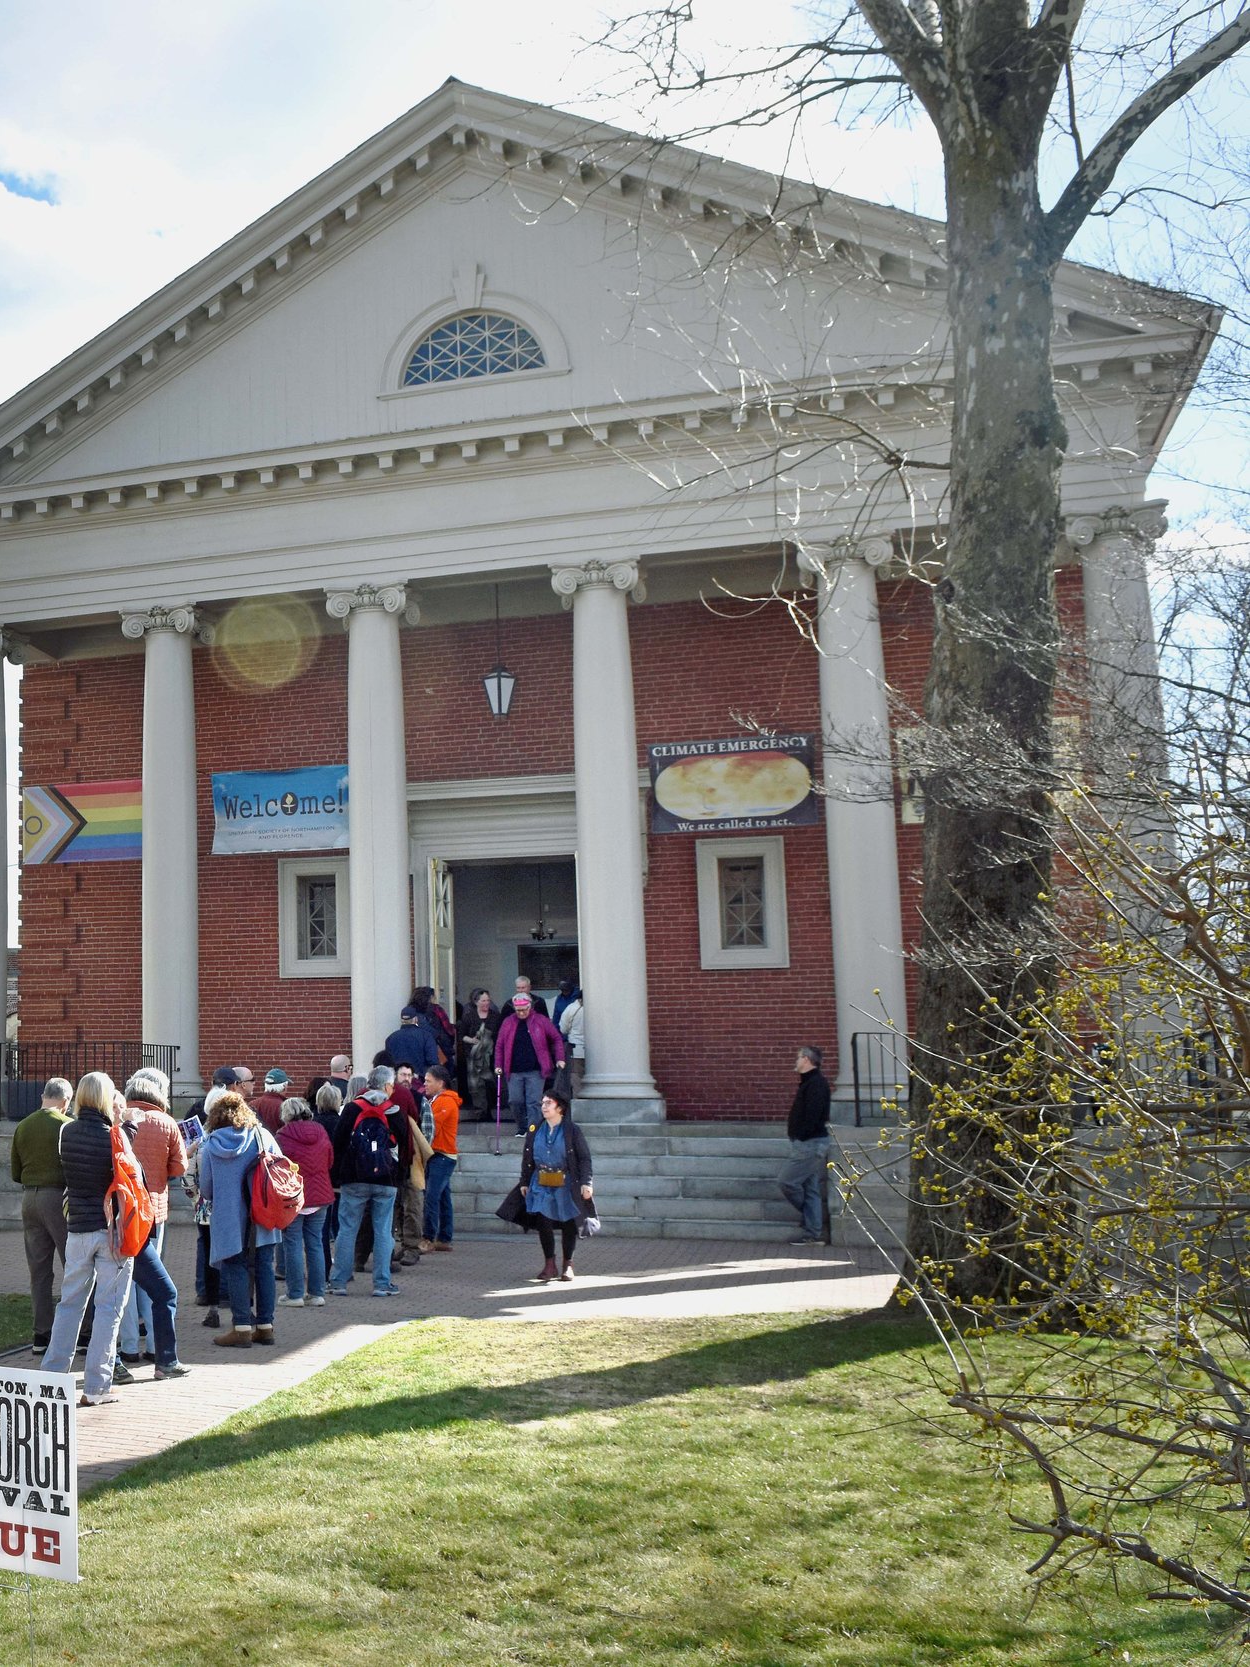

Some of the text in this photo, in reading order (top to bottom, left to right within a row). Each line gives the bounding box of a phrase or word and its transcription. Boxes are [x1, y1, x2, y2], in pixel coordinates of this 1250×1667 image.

[652, 737, 808, 757] CLIMATE EMERGENCY
[221, 788, 344, 820] Welcome!
[291, 825, 335, 833] NORTHAMPTON
[677, 822, 694, 831] We
[697, 822, 715, 831] are
[718, 818, 751, 829] called
[756, 819, 768, 827] to
[39, 1384, 67, 1400] MA
